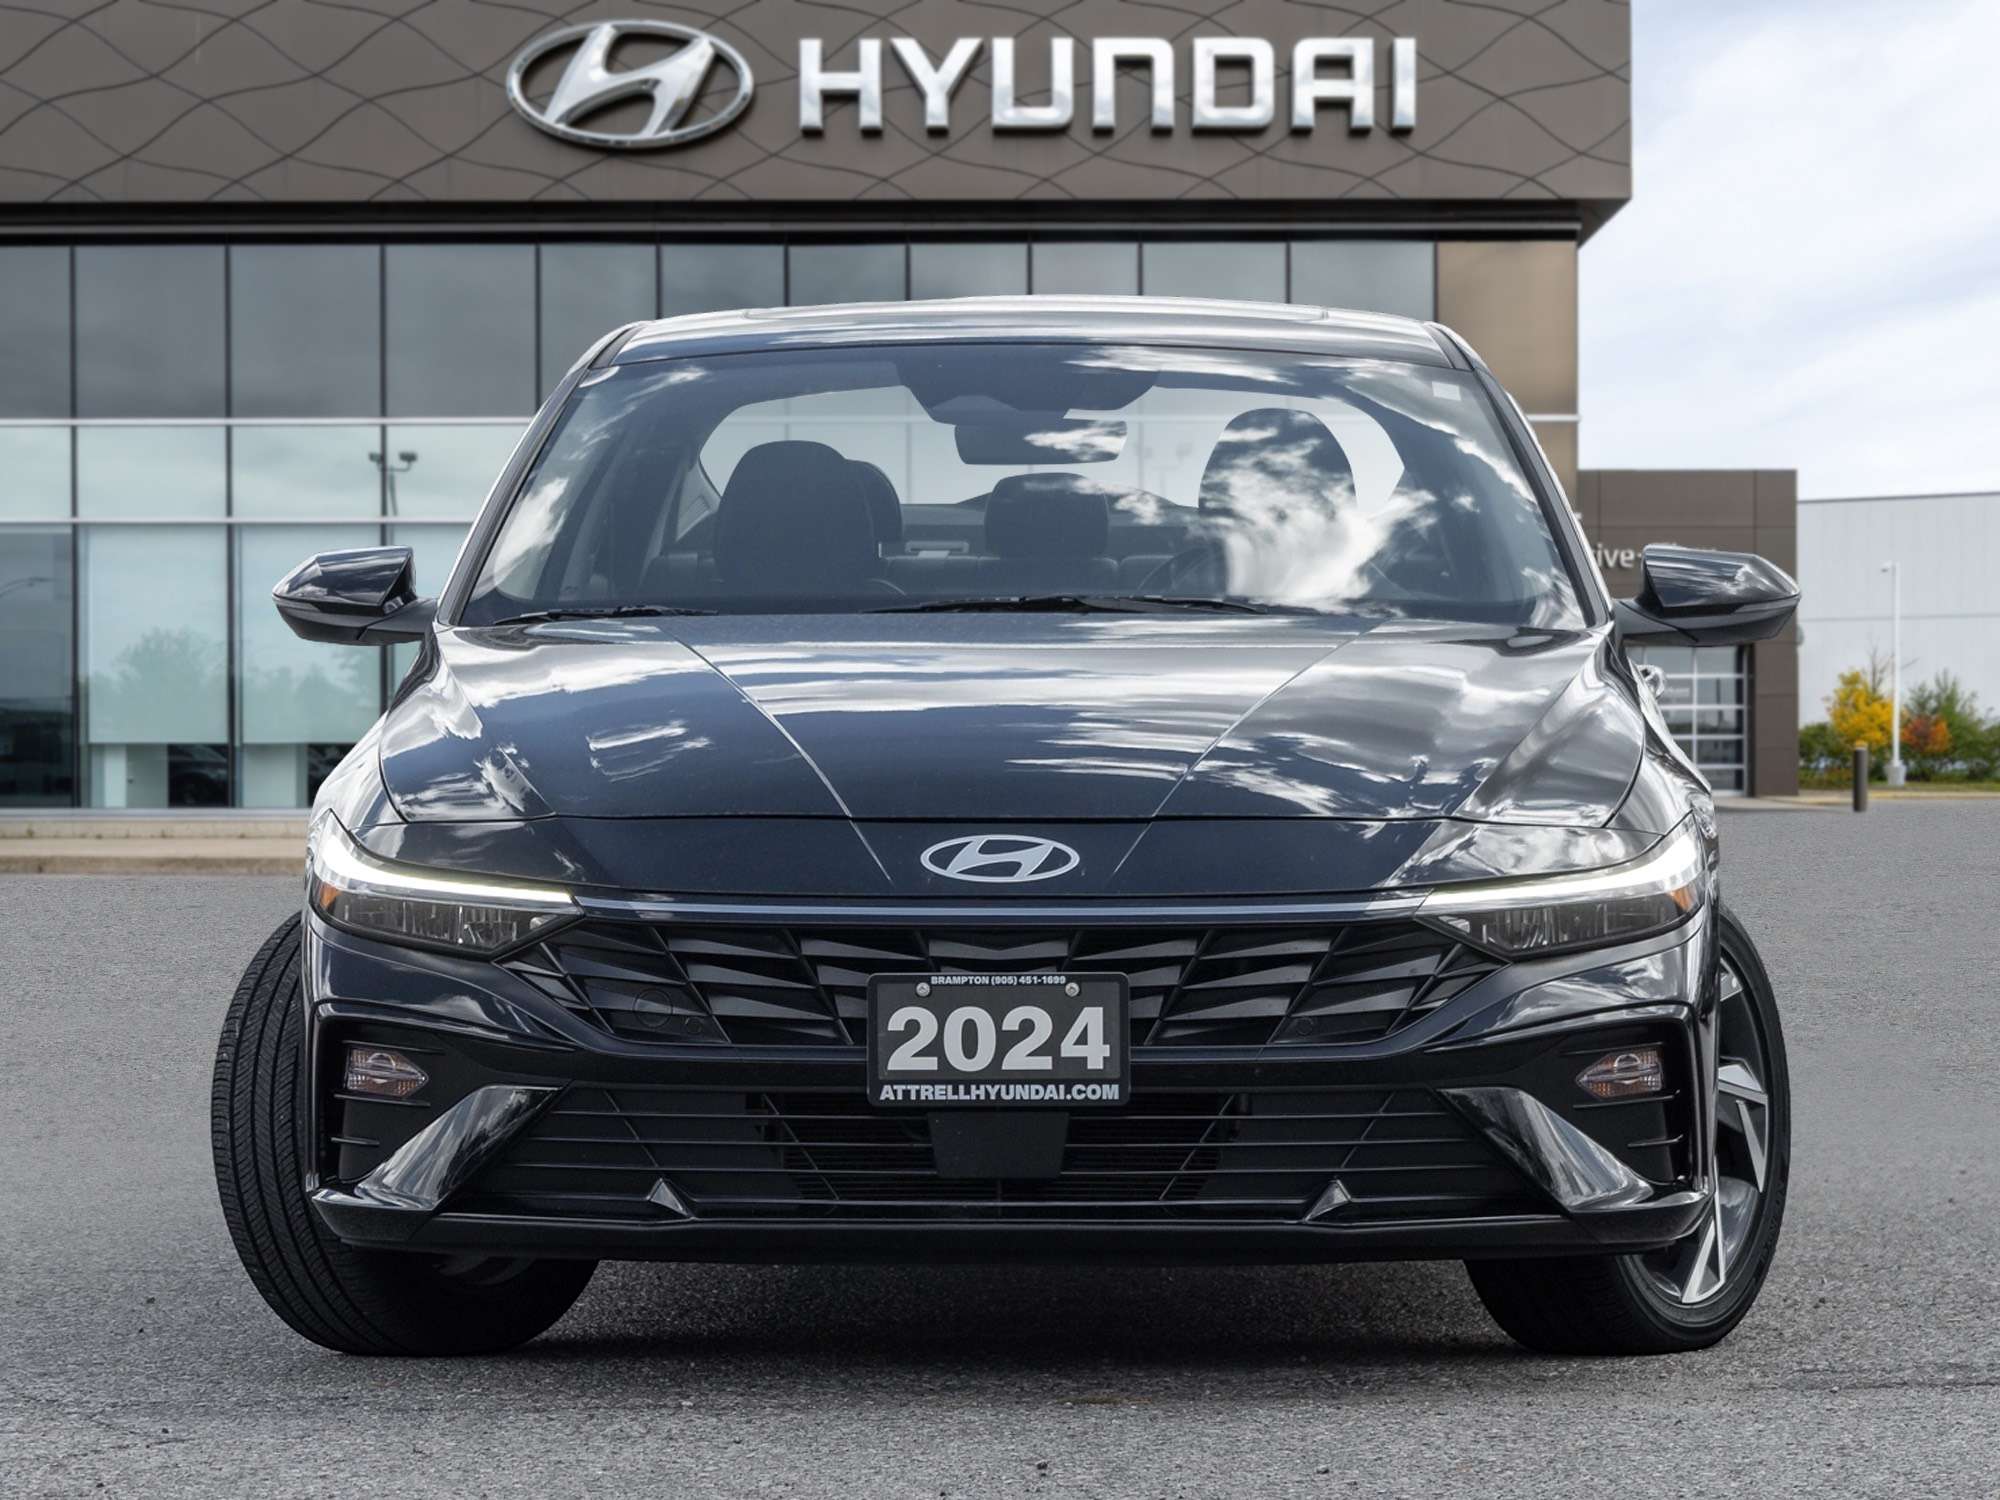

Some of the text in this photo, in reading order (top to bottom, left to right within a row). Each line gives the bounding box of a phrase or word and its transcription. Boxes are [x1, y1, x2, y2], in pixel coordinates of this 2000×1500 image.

[798, 36, 1418, 132] HYUNDAI
[930, 975, 989, 985] BRAMPTON
[991, 975, 1018, 987] (905)
[887, 1005, 1110, 1072] 2024
[879, 1083, 1120, 1101] ATTRELLHYUNDAI.COM
